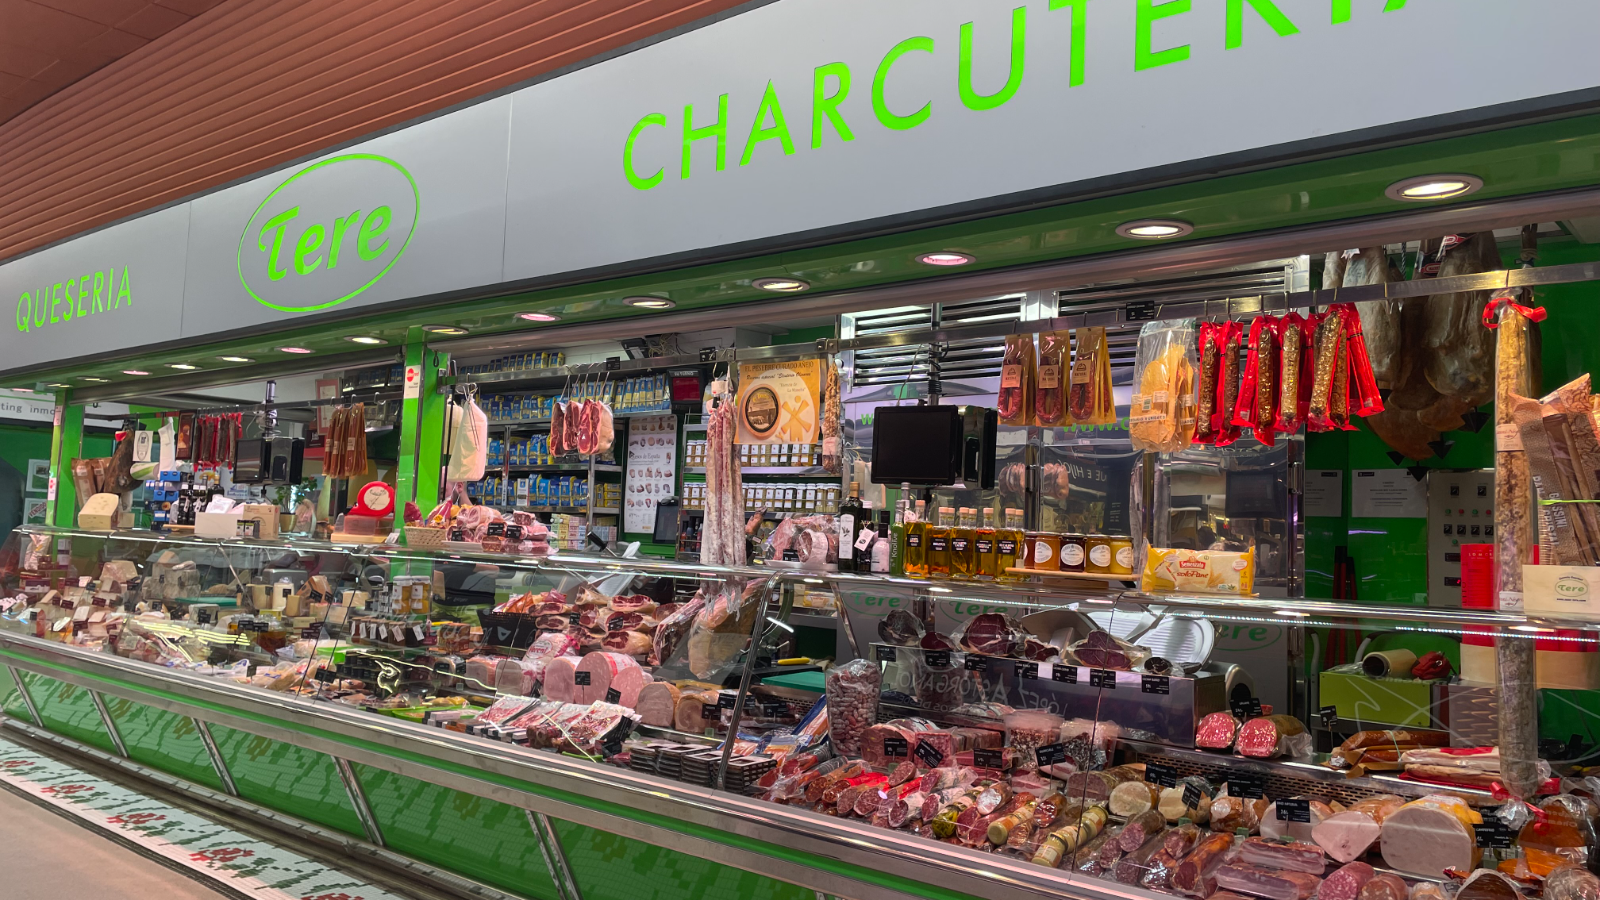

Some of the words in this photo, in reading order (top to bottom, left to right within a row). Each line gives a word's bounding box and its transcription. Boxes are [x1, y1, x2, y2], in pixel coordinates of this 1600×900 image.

[622, 0, 1406, 190] CHARCUTE
[257, 205, 393, 281] Tere
[16, 265, 133, 332] QUESERIA
[850, 594, 900, 608] Tere
[948, 599, 1009, 616] Tere
[1557, 584, 1585, 592] Tere
